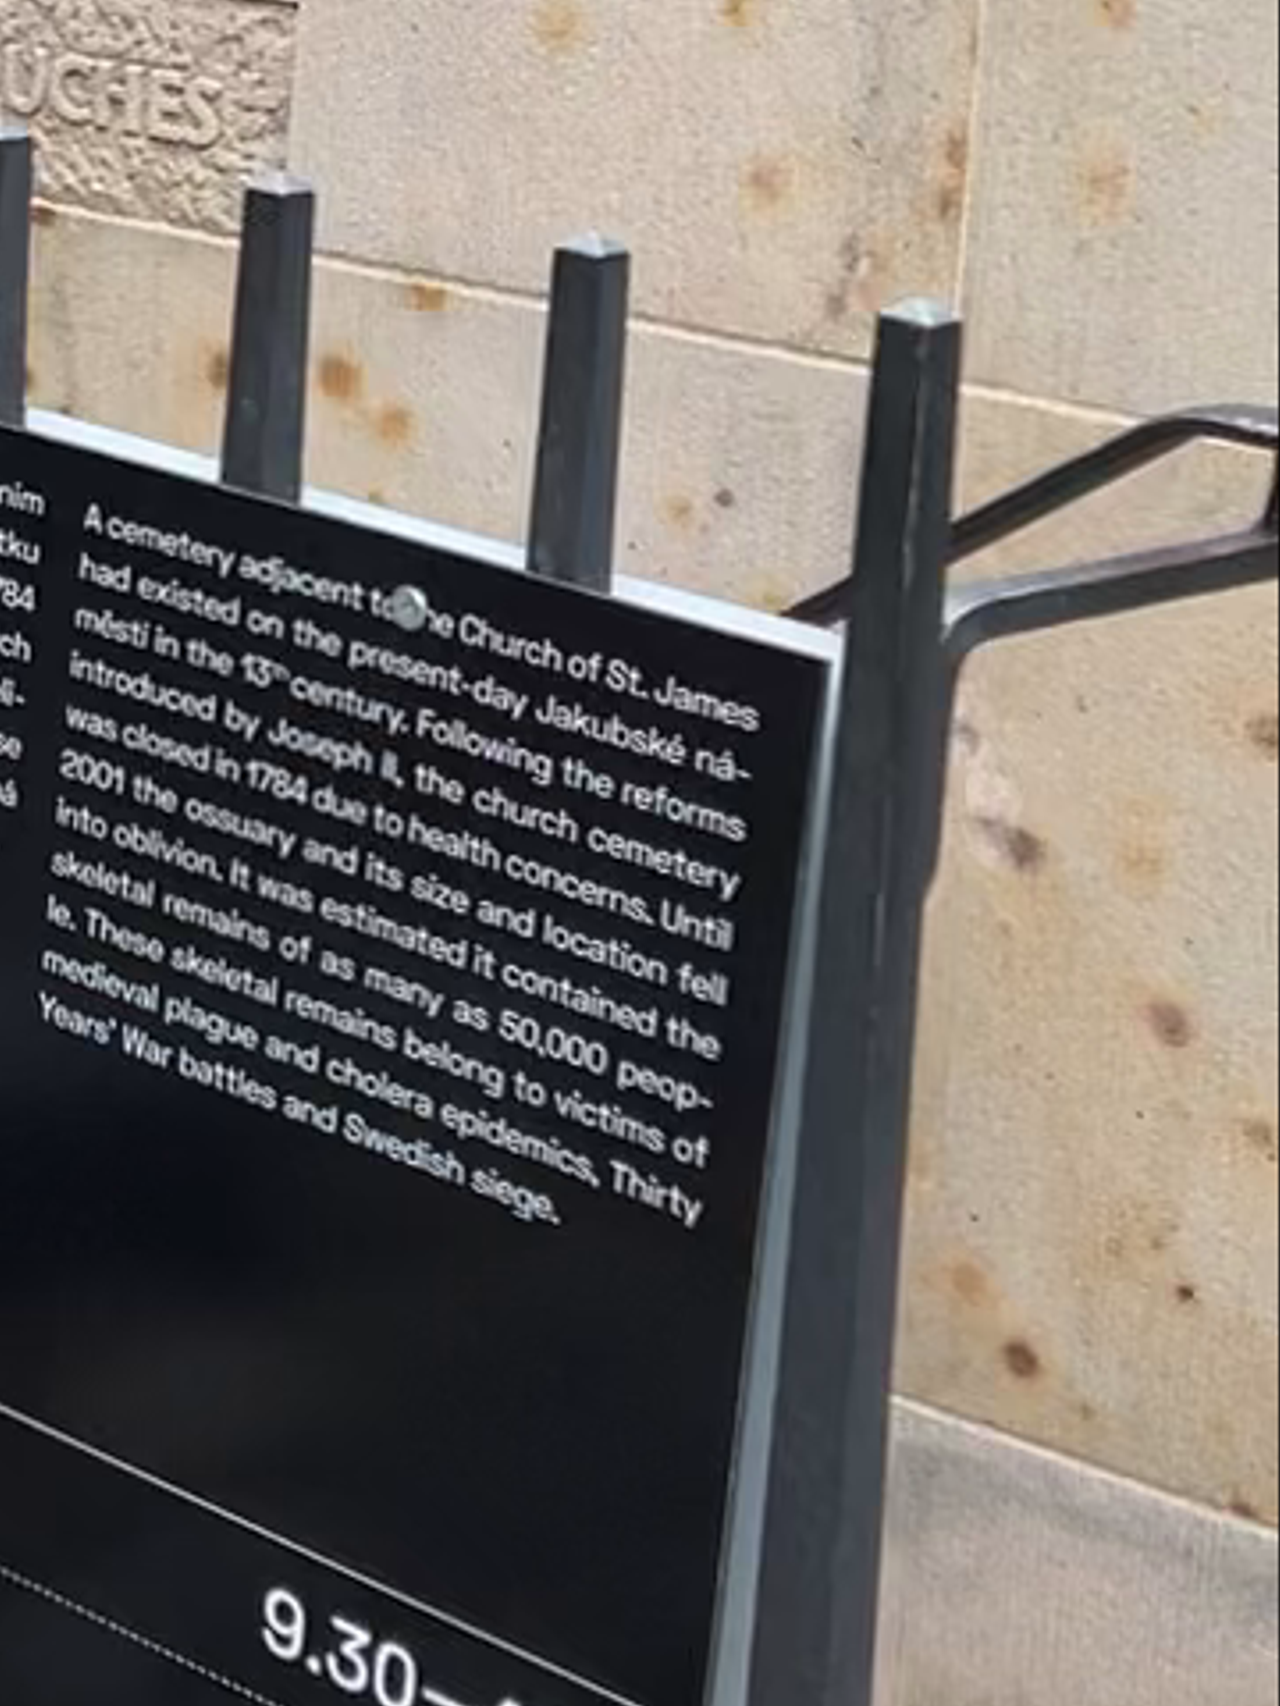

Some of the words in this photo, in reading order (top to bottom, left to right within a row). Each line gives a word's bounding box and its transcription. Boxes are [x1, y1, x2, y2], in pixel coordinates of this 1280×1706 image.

[78, 551, 131, 592] had
[136, 576, 240, 625] existed
[246, 609, 284, 638] on
[292, 618, 342, 656] the
[347, 640, 529, 720] present-day
[534, 694, 686, 765] Jakubské
[83, 502, 103, 533] A
[105, 516, 235, 577] cemetery
[237, 554, 364, 610] adjacent
[458, 613, 562, 671] Church
[566, 652, 602, 682] of
[604, 658, 649, 699] St.
[652, 675, 759, 731] James
[153, 625, 180, 658] in
[186, 639, 234, 675] the
[289, 675, 408, 734] century.
[415, 707, 553, 786] Following
[561, 756, 615, 798] the
[620, 782, 746, 841] reforms
[59, 747, 125, 794] 2001
[132, 775, 178, 813] the
[183, 797, 296, 858] ossuary
[301, 838, 358, 875] and
[364, 851, 403, 891] its
[410, 873, 470, 914] size
[476, 899, 536, 938] and
[542, 914, 668, 984] location
[676, 962, 728, 1005] fell
[65, 705, 117, 741] was
[121, 723, 210, 772] closed
[214, 747, 240, 782] in
[245, 759, 308, 804] 1784
[311, 785, 368, 824] due
[373, 804, 404, 837] to
[406, 813, 501, 870] health
[504, 854, 654, 925] concerns.
[659, 898, 733, 950] Until
[69, 649, 216, 721] introduced
[223, 700, 260, 741] by
[267, 718, 373, 773] Joseph
[414, 763, 465, 804] the
[471, 786, 578, 842] church
[586, 826, 740, 901] cemetery
[50, 850, 155, 907] skeletal
[162, 893, 270, 950] remains
[278, 935, 311, 963] of
[319, 950, 355, 981] as
[363, 966, 444, 1017] many
[452, 999, 489, 1031] as
[55, 795, 108, 839] into
[112, 822, 223, 881] oblivion.
[229, 857, 250, 891] It
[257, 874, 313, 912] was
[319, 897, 468, 968] estimated
[472, 943, 496, 980] it
[501, 963, 658, 1037] contained
[665, 1015, 720, 1059] the
[85, 907, 164, 962] These
[170, 945, 278, 1005] skeletal
[284, 990, 397, 1050] remains
[402, 1027, 505, 1098] belong
[512, 1070, 546, 1106] to
[553, 1089, 665, 1152] victims
[671, 1136, 708, 1167] of
[41, 949, 159, 1011] medieval
[163, 996, 259, 1050] plague
[264, 1035, 320, 1073] and
[325, 1057, 433, 1118] cholera
[609, 1159, 702, 1227] Thirty
[121, 1023, 173, 1067] War
[178, 1046, 277, 1109] battles
[282, 1095, 338, 1133] and
[342, 1112, 465, 1184] Swedish
[470, 1167, 560, 1224] siege.
